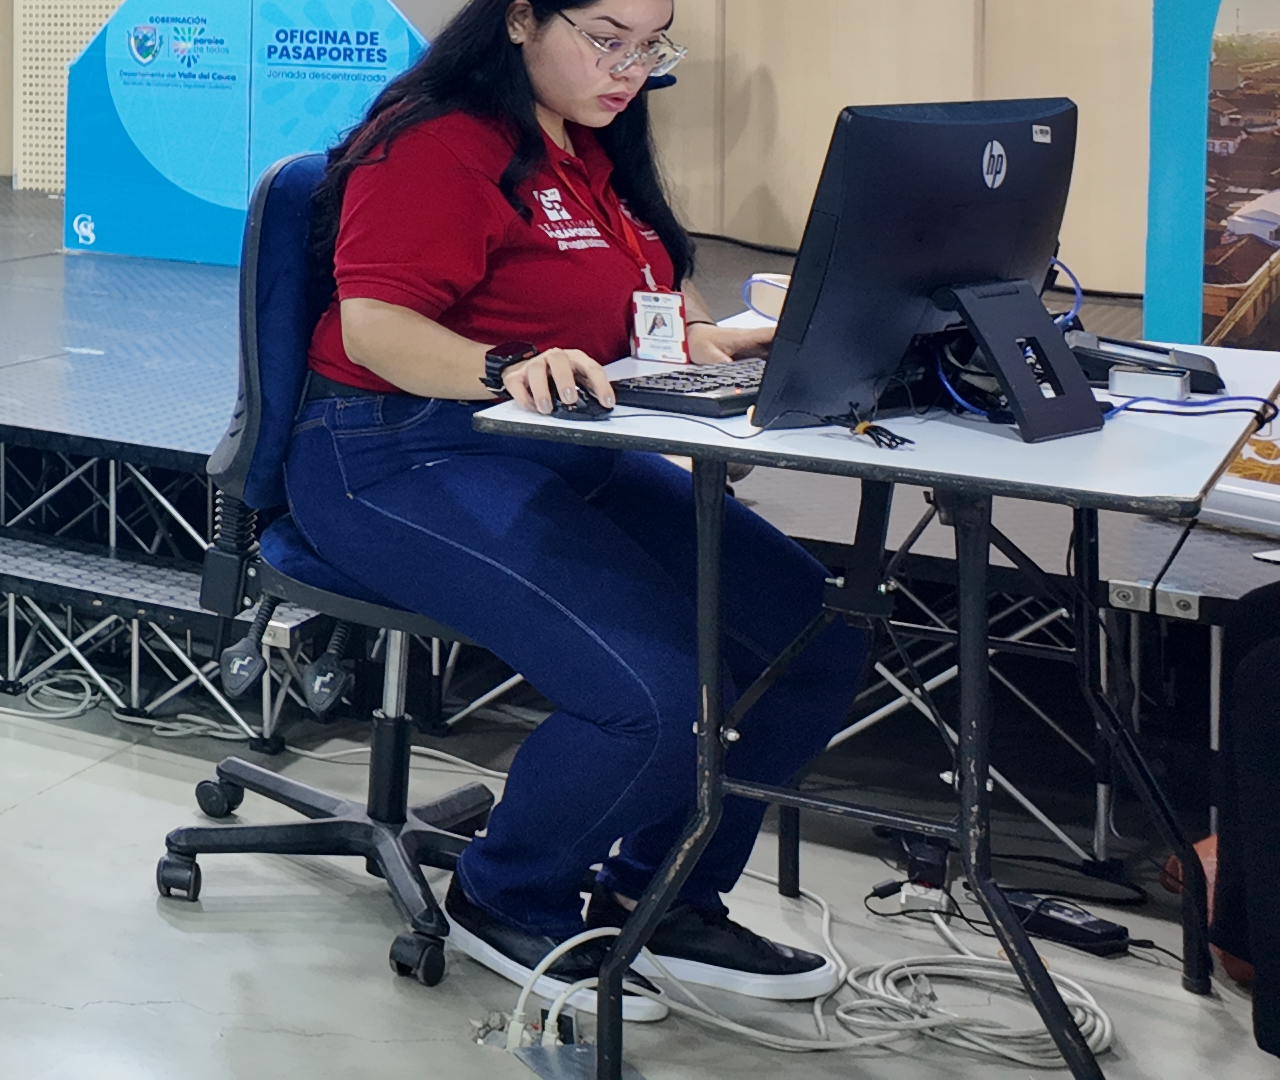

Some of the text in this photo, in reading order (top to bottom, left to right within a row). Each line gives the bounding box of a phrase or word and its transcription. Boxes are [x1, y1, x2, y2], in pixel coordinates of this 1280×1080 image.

[275, 29, 379, 46] OFICINA DE
[267, 44, 387, 63] PASAPORTES
[267, 69, 387, 83] Jornada descentralizada
